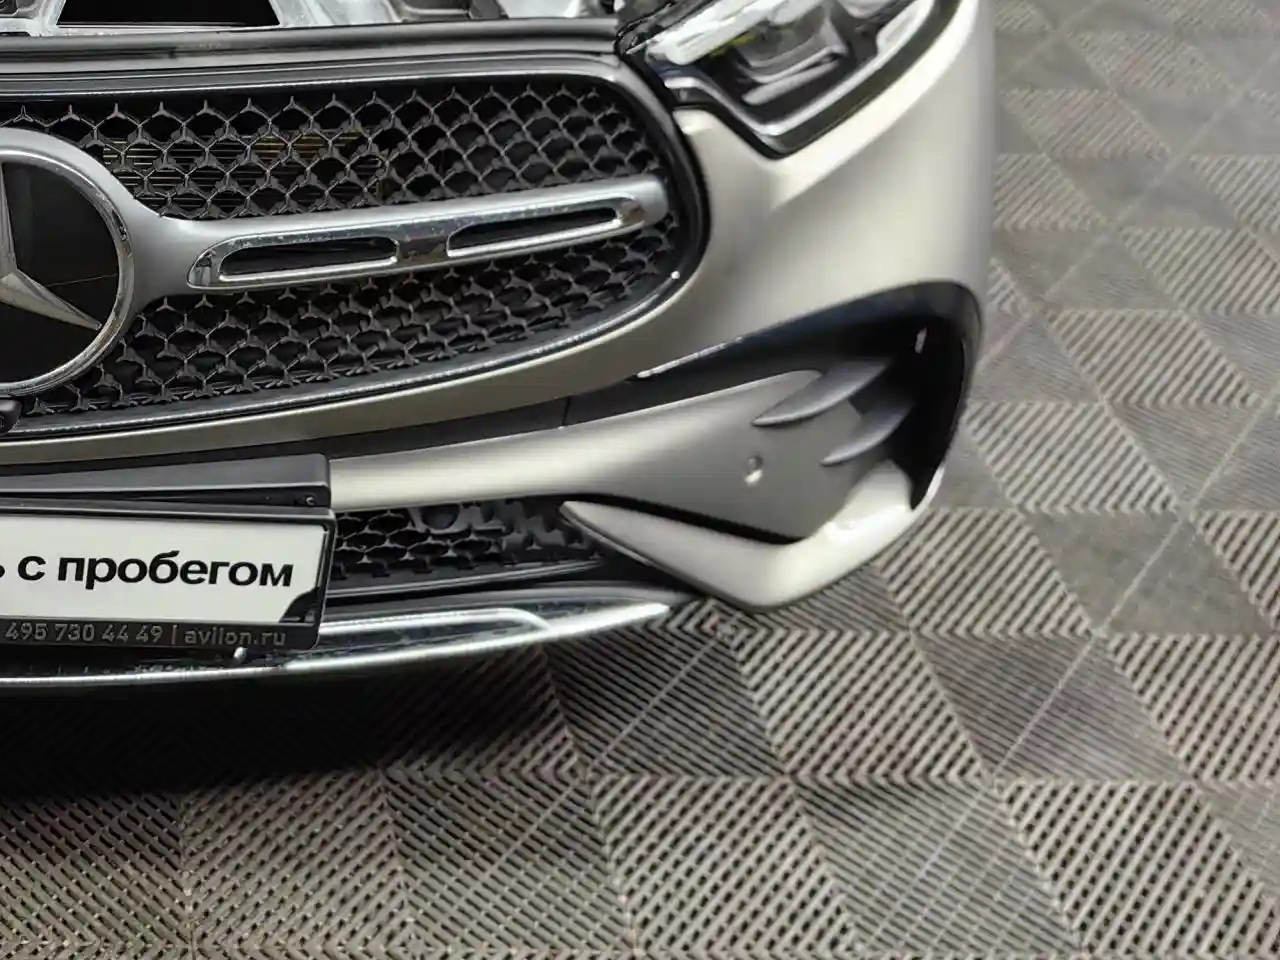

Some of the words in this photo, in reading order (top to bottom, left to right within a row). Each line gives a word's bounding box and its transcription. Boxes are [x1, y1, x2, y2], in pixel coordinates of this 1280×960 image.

[18, 555, 47, 581] с
[57, 550, 294, 591] пробегом
[5, 622, 47, 641] 495
[54, 623, 95, 642] 730
[102, 624, 129, 643] 44
[135, 625, 163, 643] 49
[184, 626, 287, 646] avilon.ru
